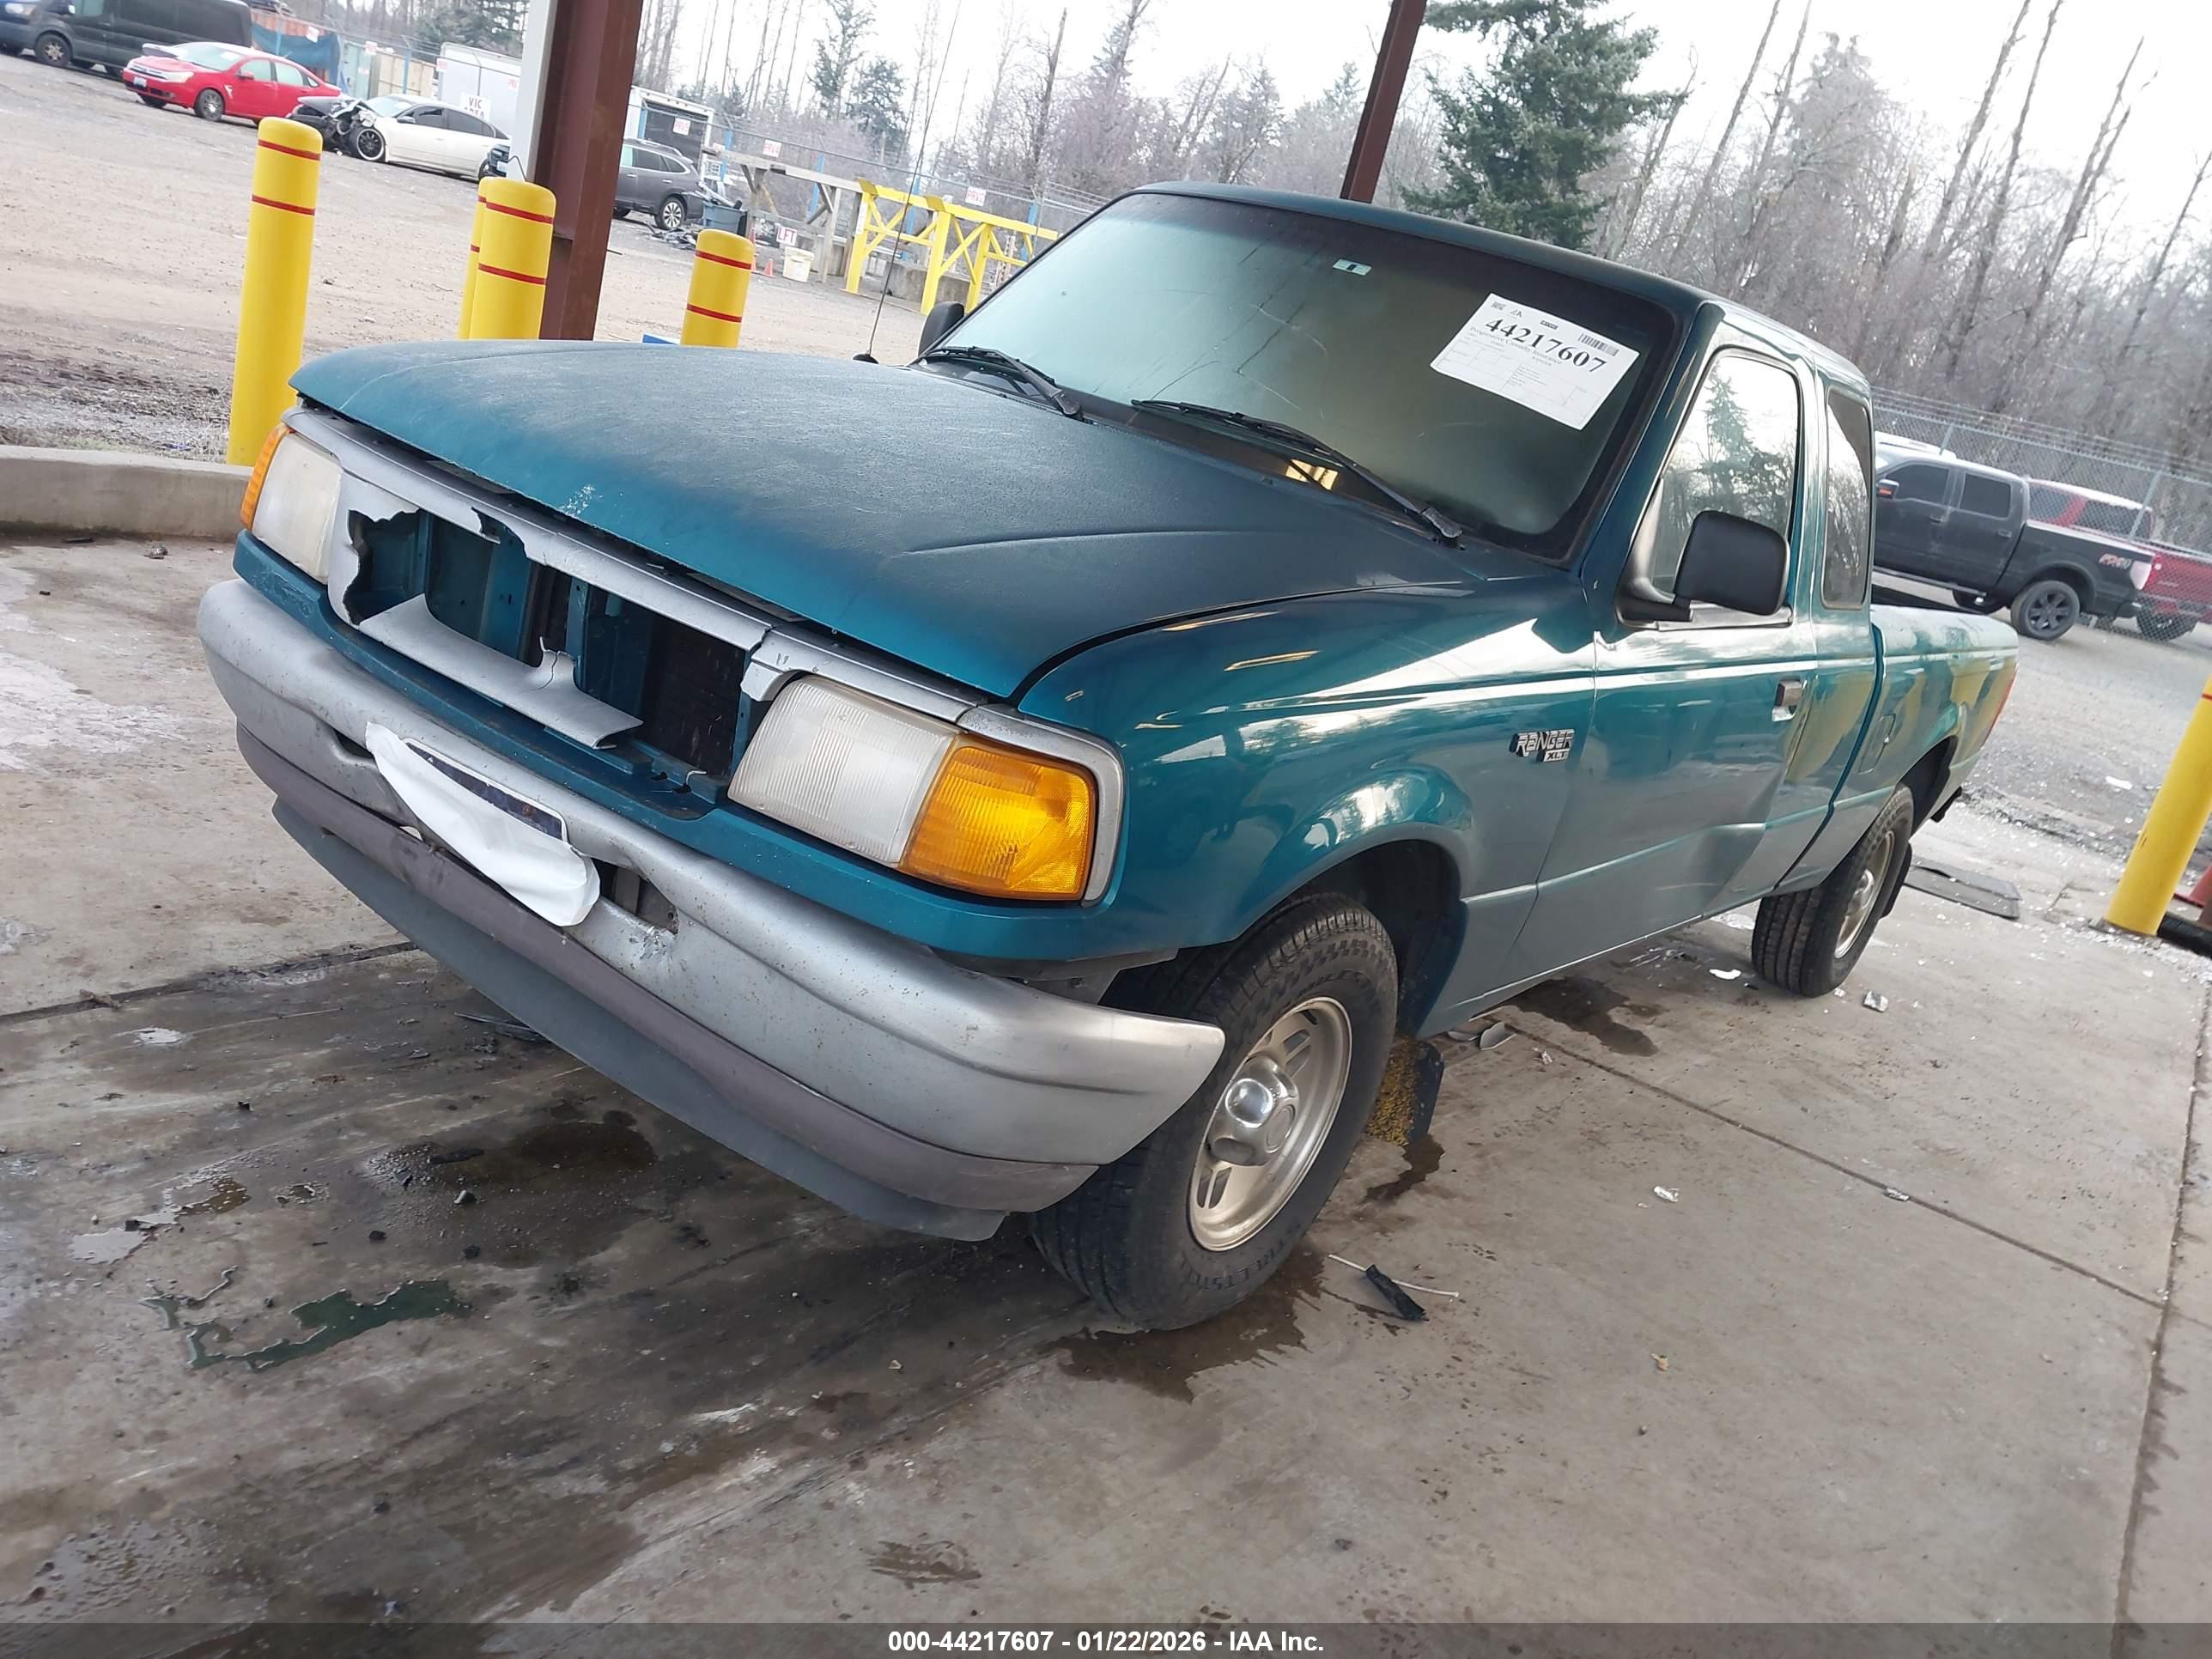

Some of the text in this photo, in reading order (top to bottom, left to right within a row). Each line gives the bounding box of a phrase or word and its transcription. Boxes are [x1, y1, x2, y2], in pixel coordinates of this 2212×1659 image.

[469, 97, 483, 109] VIC
[777, 226, 796, 243] LFT
[1486, 319, 1607, 373] 44217607
[1515, 728, 1575, 757] RANGER
[1546, 750, 1568, 761] XLT
